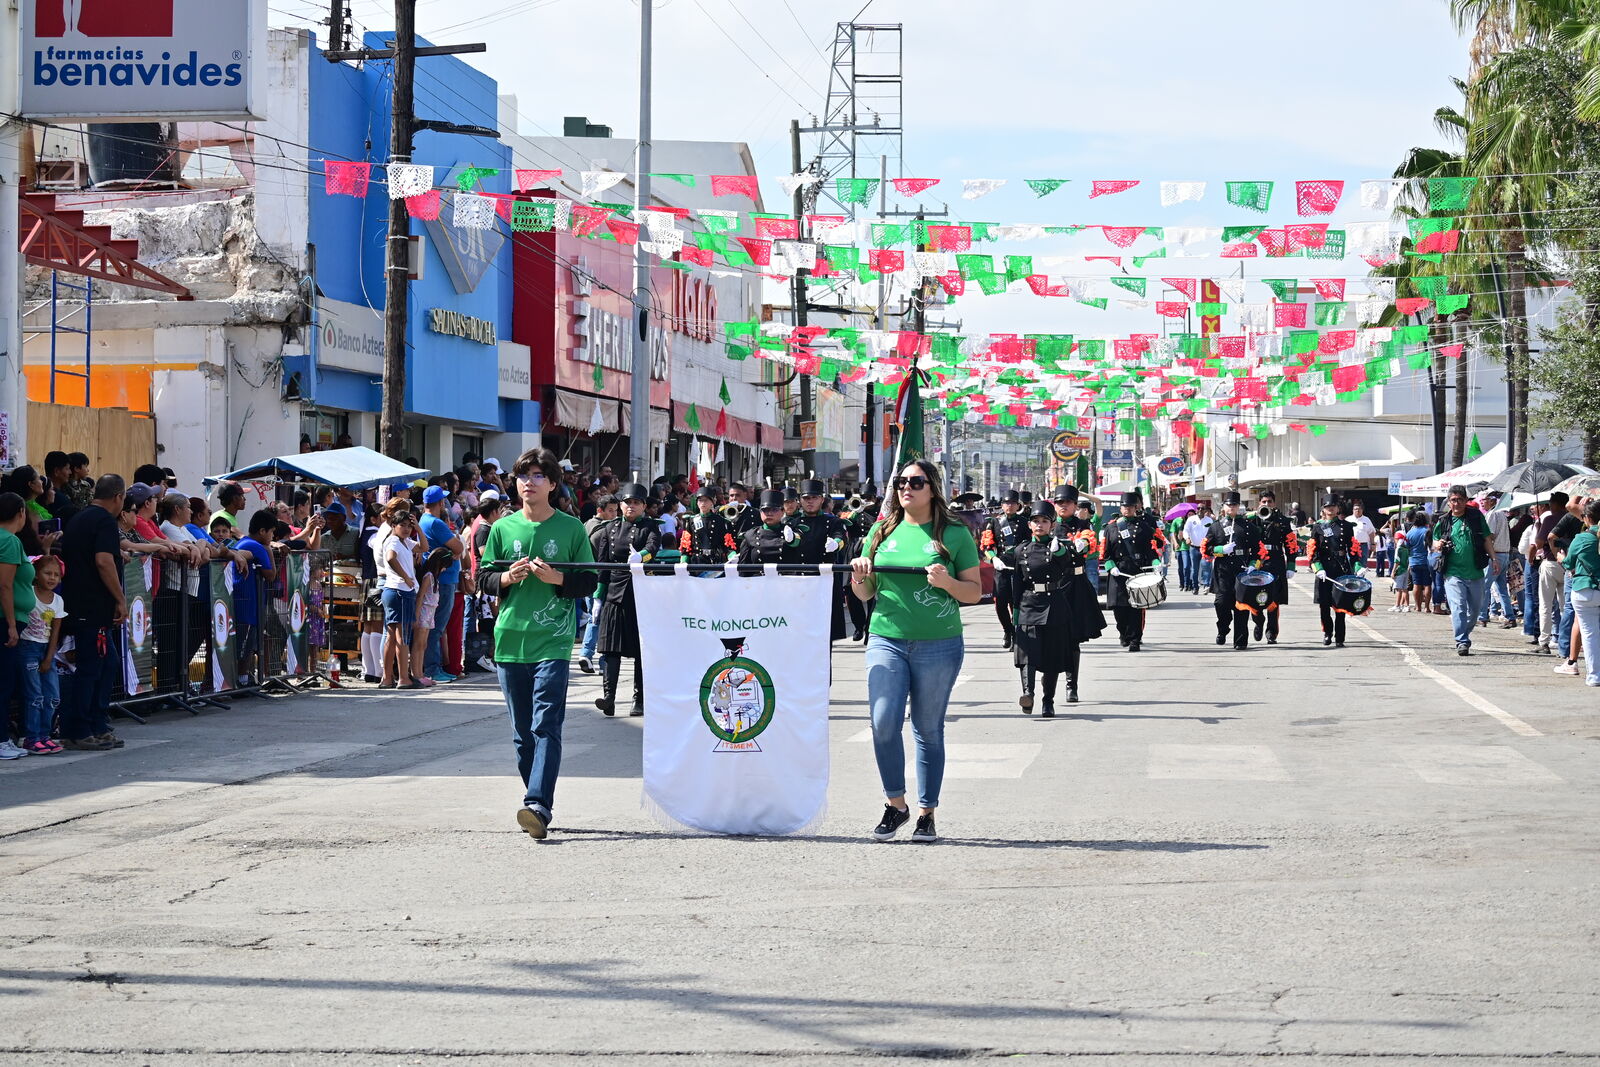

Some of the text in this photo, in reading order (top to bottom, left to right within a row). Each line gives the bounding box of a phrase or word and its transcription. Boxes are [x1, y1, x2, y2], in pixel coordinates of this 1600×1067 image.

[47, 46, 143, 60] farmacias
[34, 51, 242, 86] benavides
[433, 308, 466, 338] SALINAS
[470, 316, 497, 346] ROCHA
[338, 331, 361, 353] Banco
[509, 366, 529, 385] Azteca
[681, 616, 788, 631] TEC MONCLOVA
